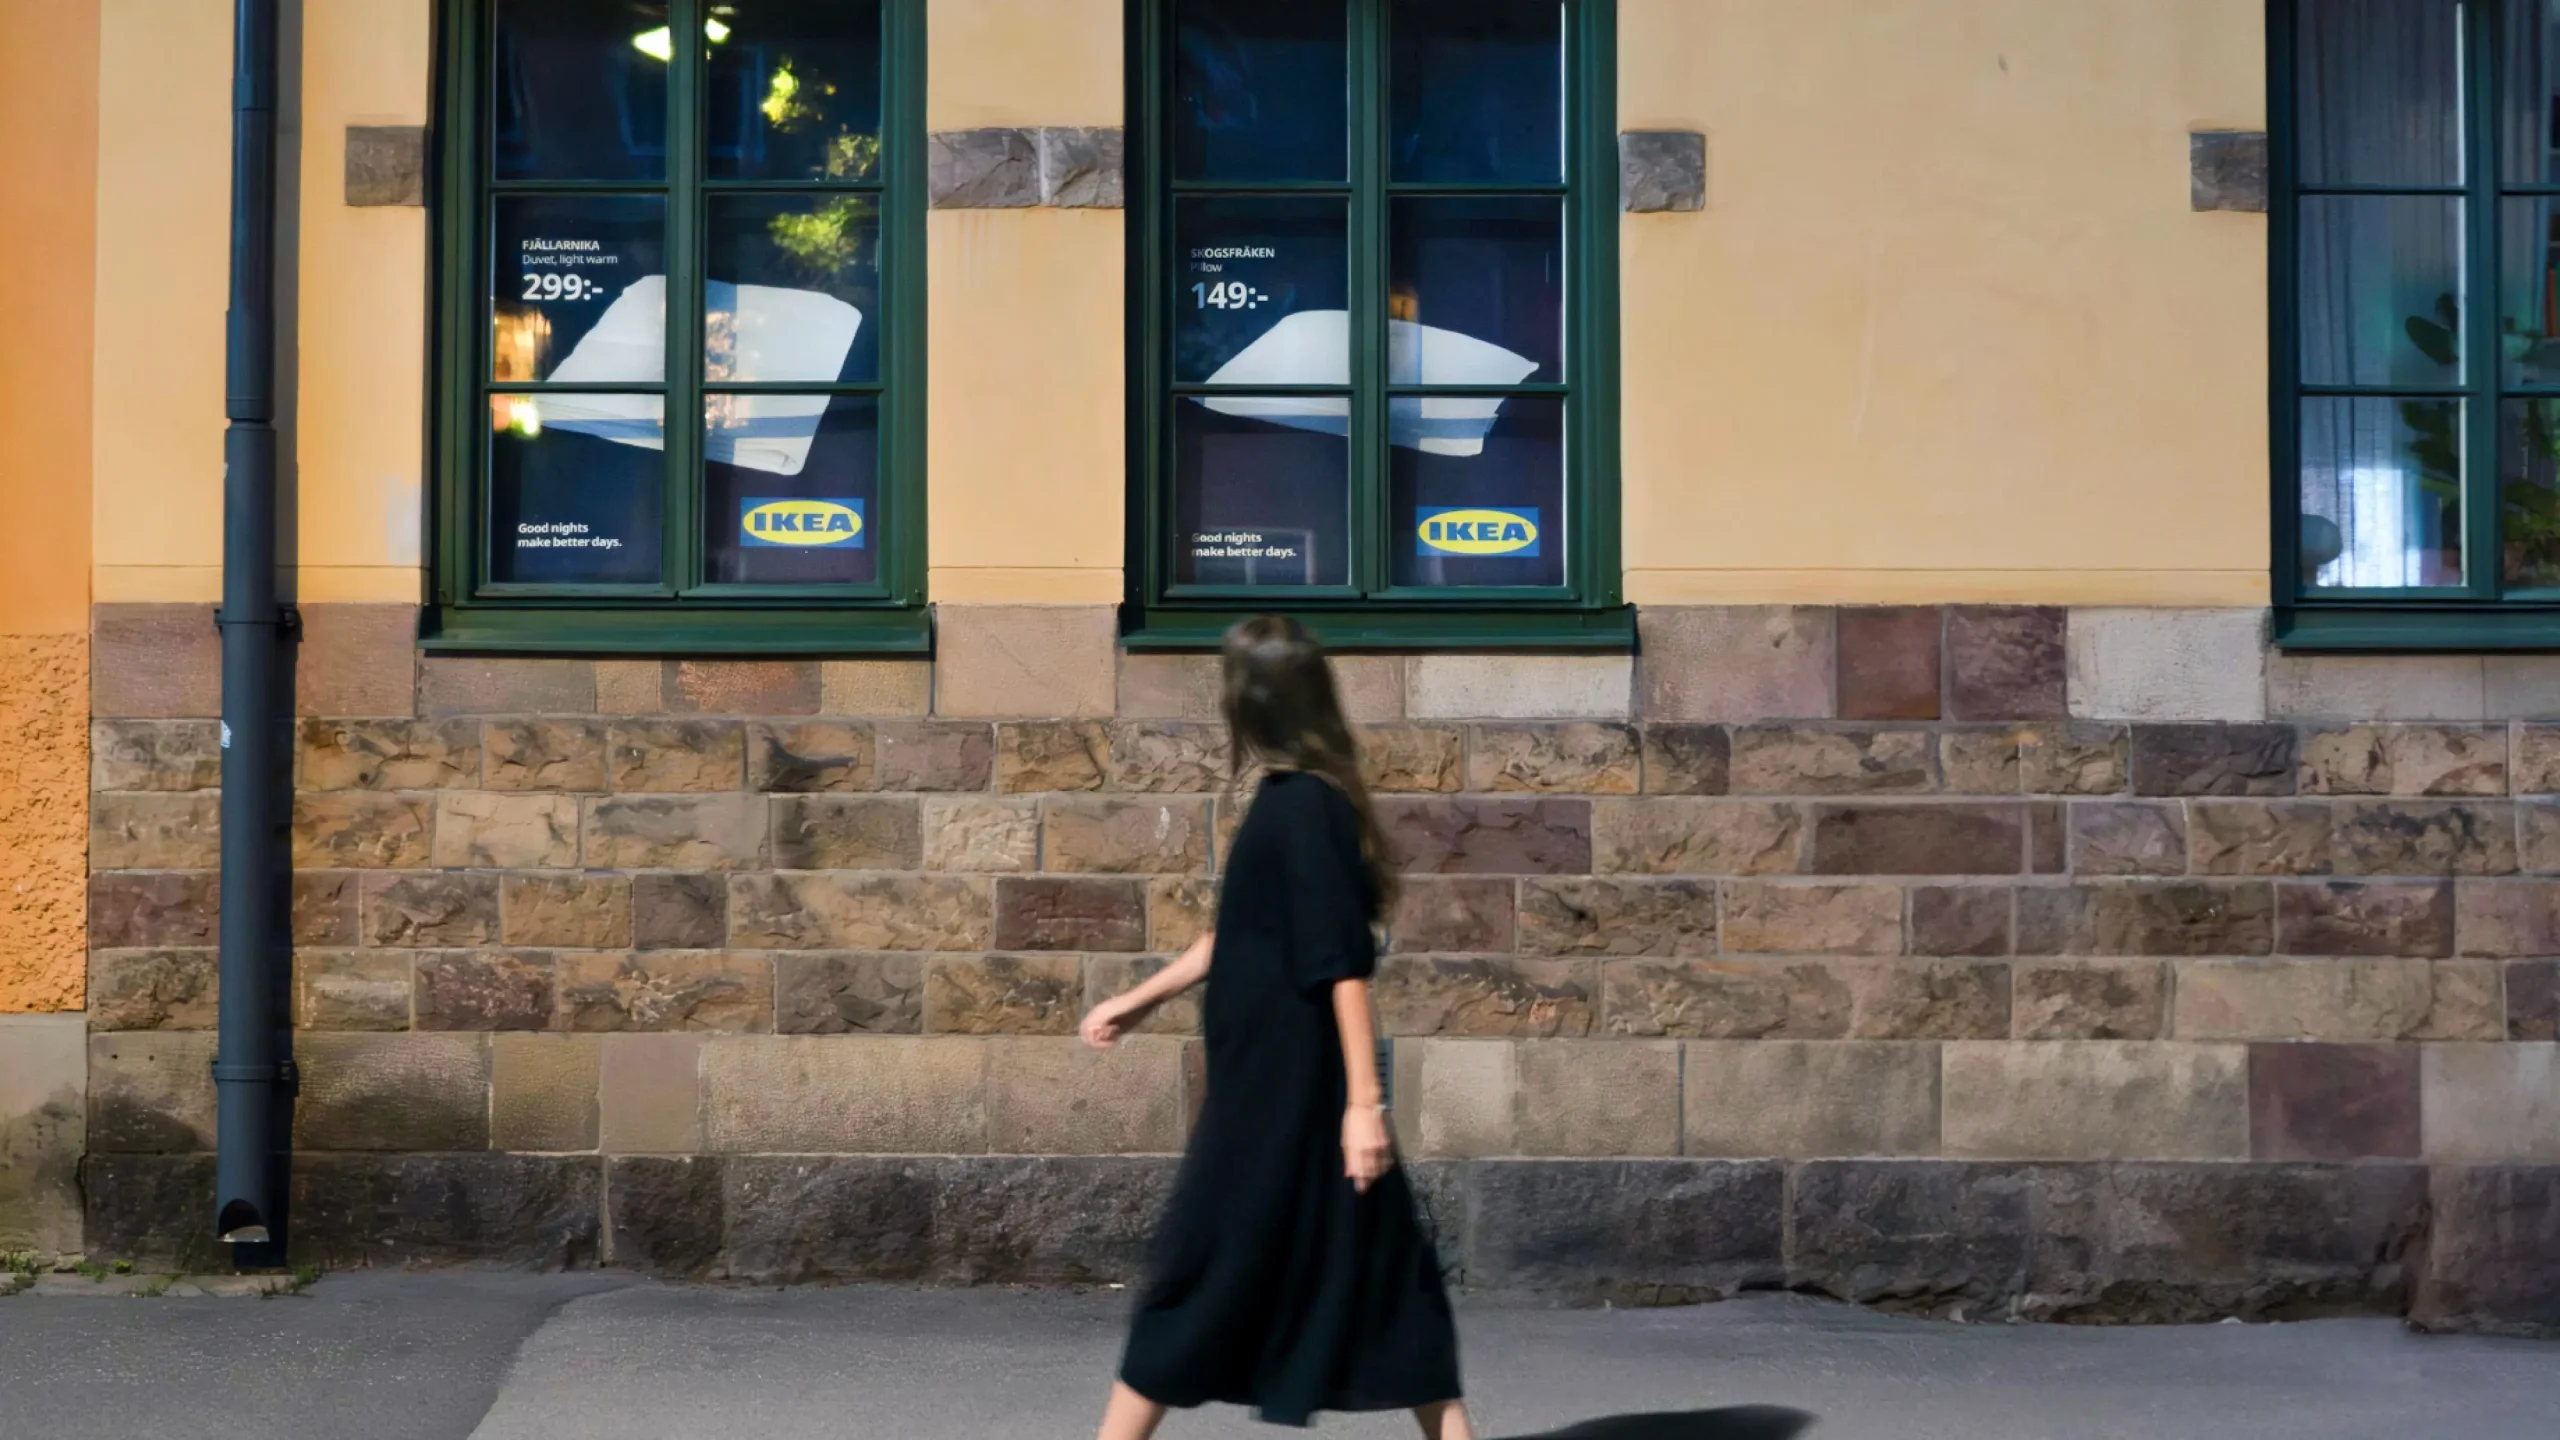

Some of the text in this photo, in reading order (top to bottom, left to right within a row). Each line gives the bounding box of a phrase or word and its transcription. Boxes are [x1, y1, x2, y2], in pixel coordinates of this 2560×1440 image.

[522, 238, 600, 251] FJÄLLARNIKA
[522, 254, 618, 267] Duvet, light warm
[522, 274, 604, 302] 299:-
[1191, 281, 1269, 310] 149:-
[754, 512, 855, 532] IKEA
[518, 522, 589, 538] Good nights
[1429, 521, 1529, 542] IKEA
[518, 536, 623, 550] make better days.
[1192, 532, 1263, 547] Good nights
[1192, 546, 1297, 560] make better days.
